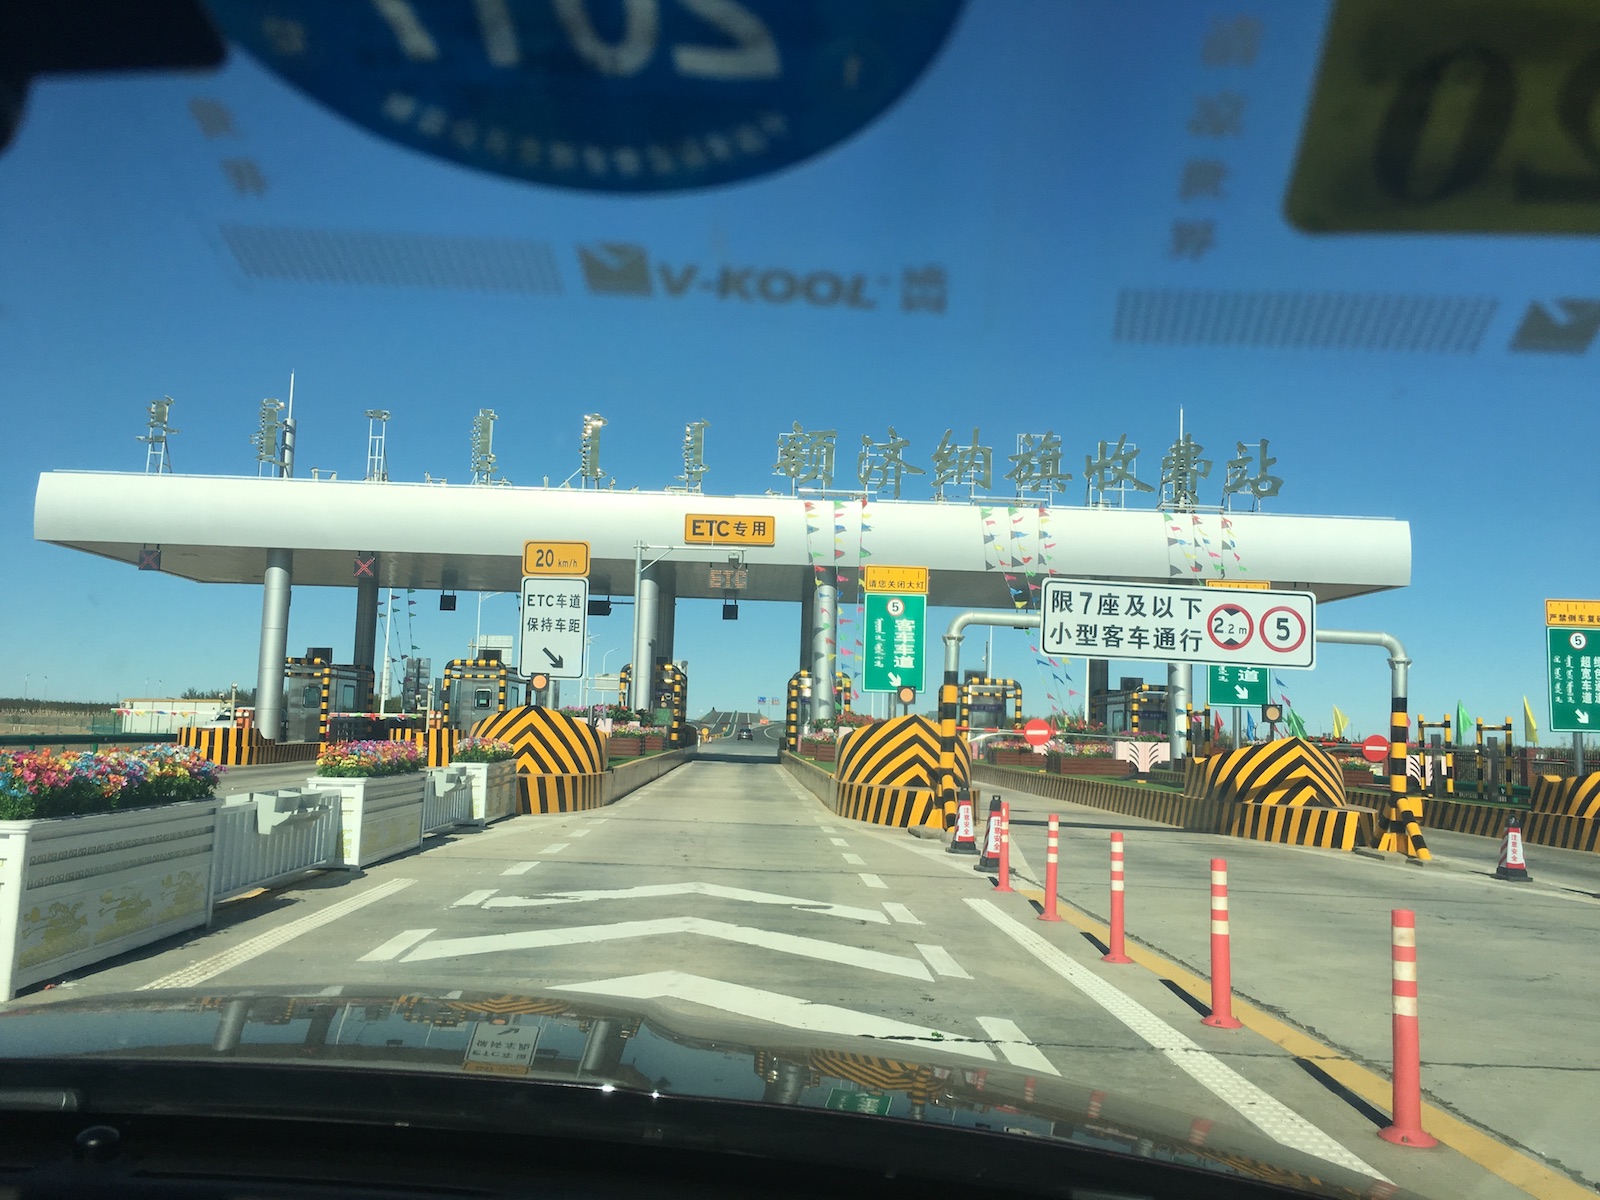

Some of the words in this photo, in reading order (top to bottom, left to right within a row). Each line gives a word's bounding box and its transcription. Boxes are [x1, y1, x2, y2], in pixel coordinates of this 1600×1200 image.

[773, 420, 1284, 504] 额济纳旗收费站
[536, 549, 554, 567] 20
[557, 559, 578, 568] km/h
[710, 569, 747, 589] ETC
[868, 580, 925, 589] 请您关闭大灯
[892, 602, 899, 612] 5
[1051, 590, 1203, 620] 限7座及以下
[527, 617, 580, 633] 保持车距
[1276, 617, 1290, 641] 5
[894, 618, 915, 668] 客车车道
[1049, 621, 1203, 653] 小型客车通行
[1575, 635, 1582, 646] 5
[1581, 656, 1592, 704] 超宽车道
